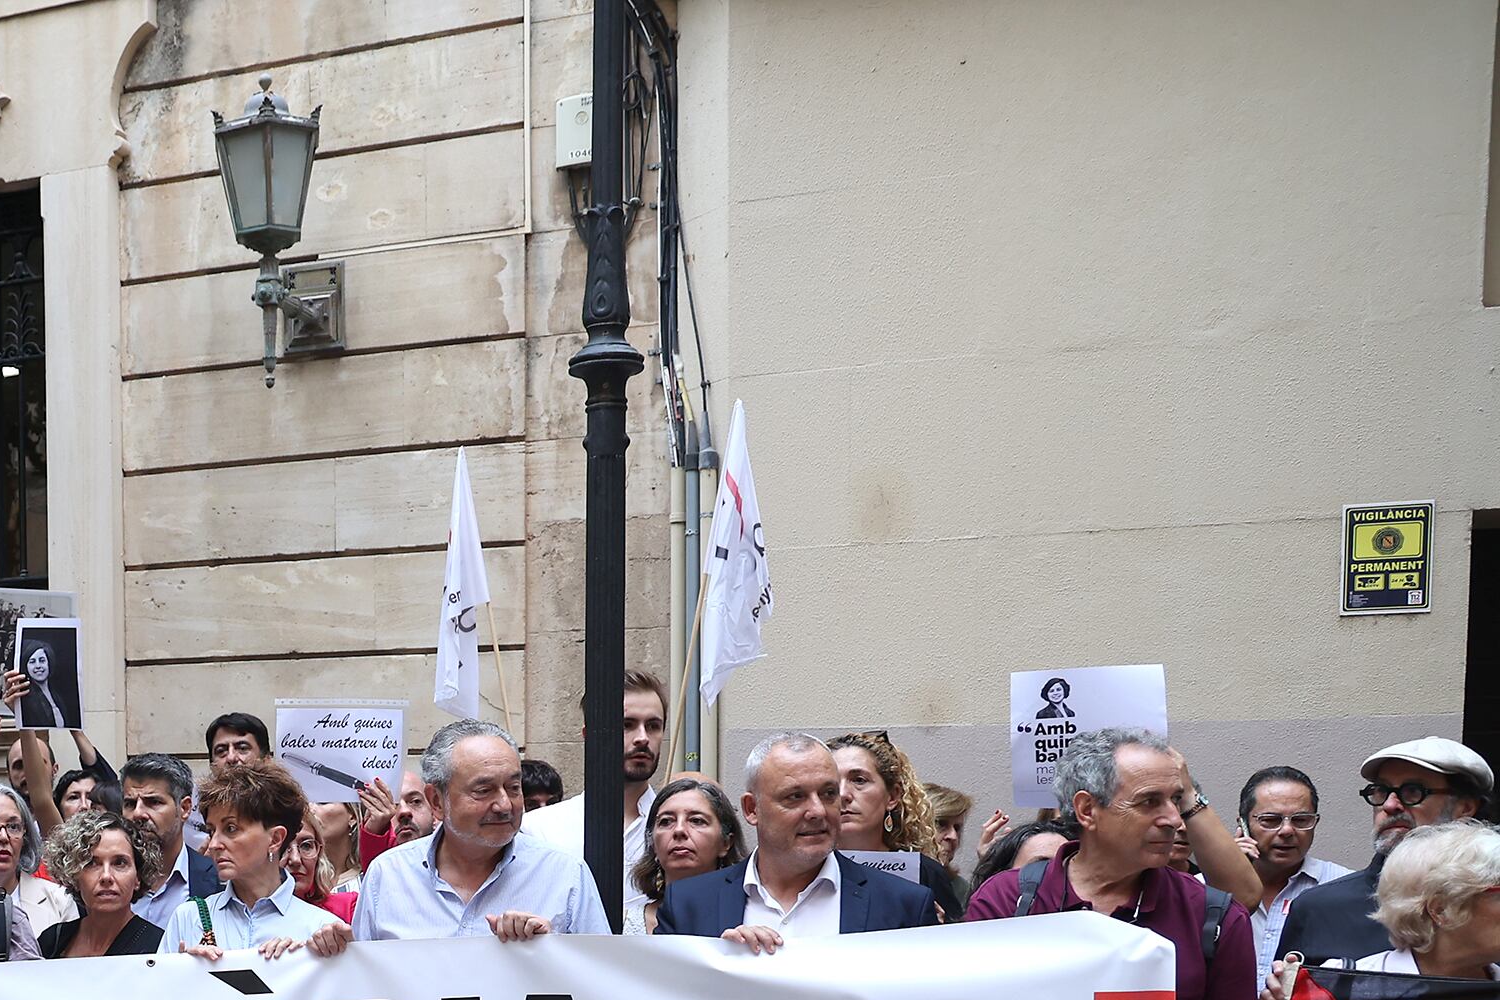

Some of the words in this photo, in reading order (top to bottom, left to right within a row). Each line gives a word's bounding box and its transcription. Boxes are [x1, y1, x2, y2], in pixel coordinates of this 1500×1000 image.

[1353, 509, 1426, 521] VIGILÀNCIA
[1350, 560, 1425, 573] PERMANENT
[313, 713, 351, 729] Amb
[353, 717, 394, 734] quines
[280, 733, 316, 749] bales
[321, 736, 378, 749] matareu
[382, 735, 398, 750] les
[361, 754, 399, 769] idees?
